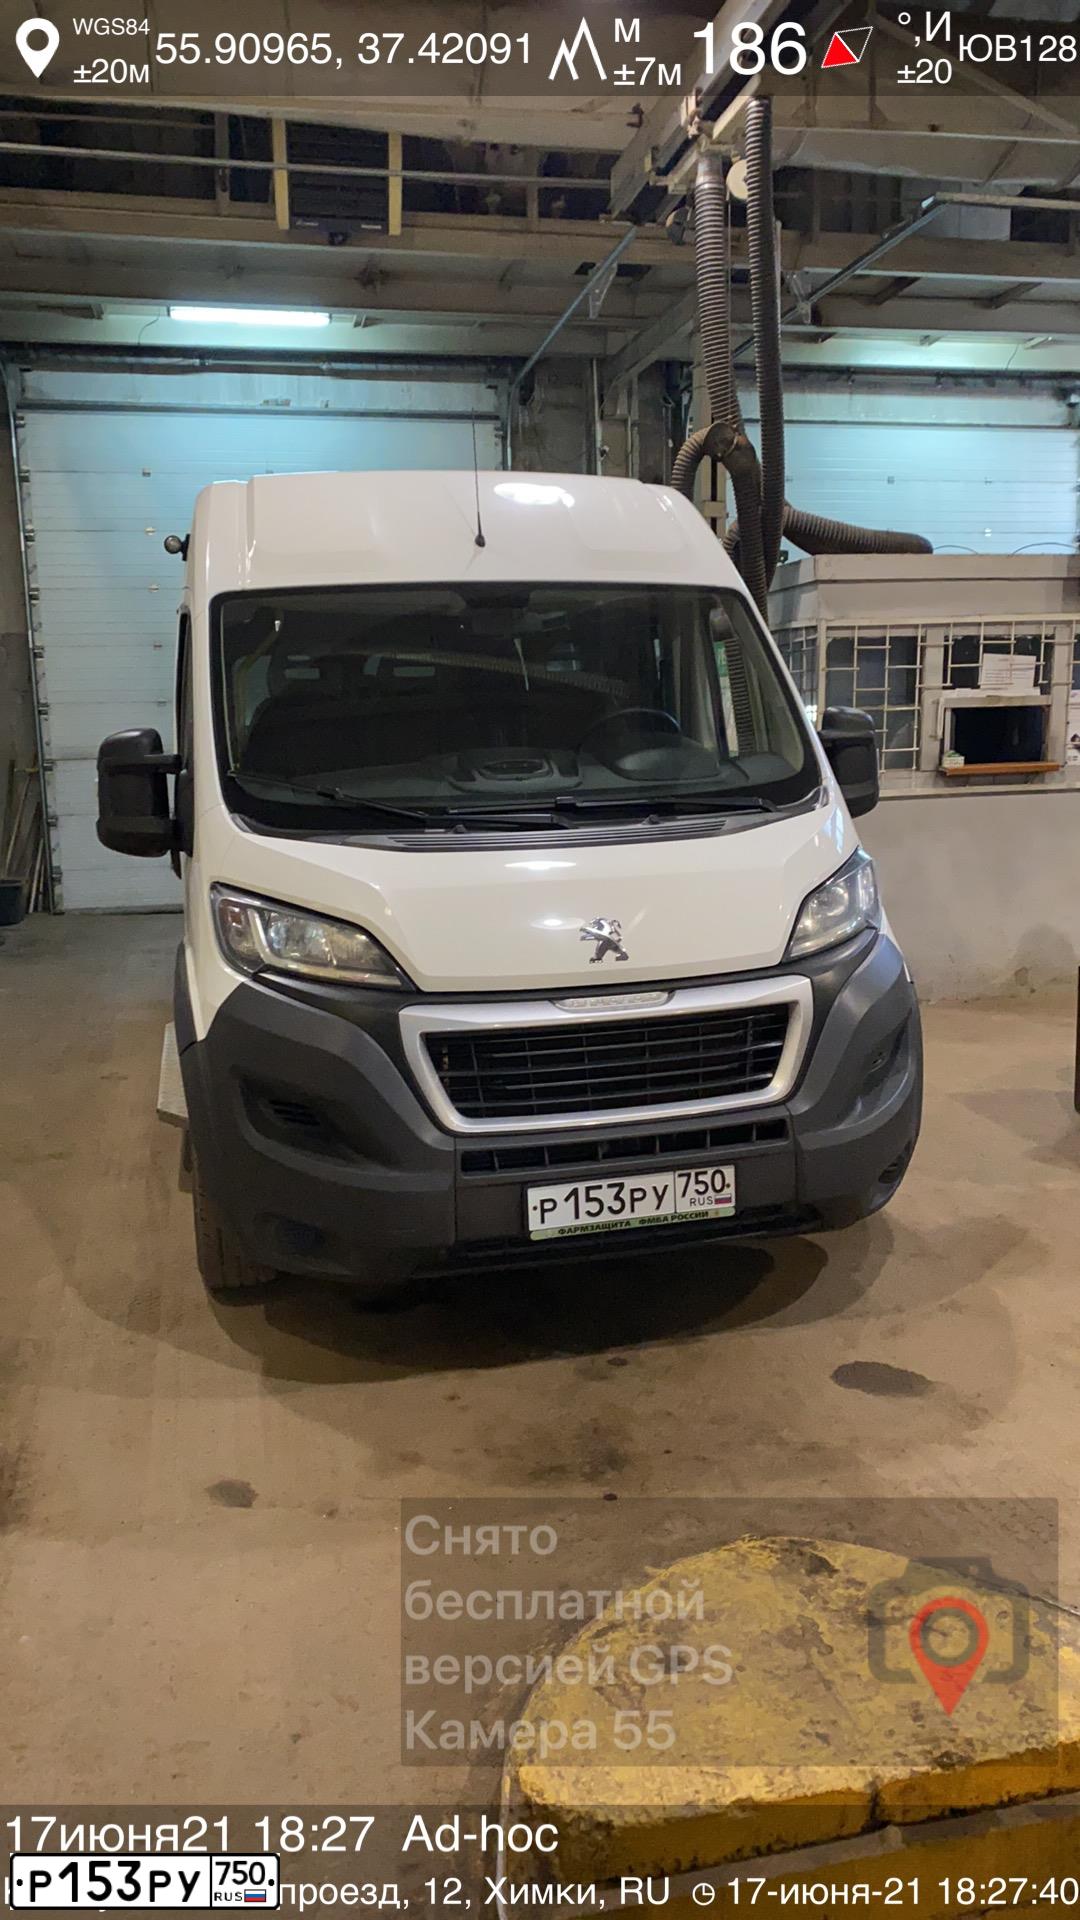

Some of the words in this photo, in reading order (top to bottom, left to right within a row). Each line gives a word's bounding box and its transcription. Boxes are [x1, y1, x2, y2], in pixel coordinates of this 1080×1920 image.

[677, 1169, 727, 1198] 750
[540, 1181, 669, 1225] Р153РУ
[689, 1196, 714, 1207] RUS
[557, 1219, 631, 1236] ФАРМЗАЩИТА
[638, 1214, 670, 1226] ФМБА
[671, 1210, 709, 1223] РОССИИ
